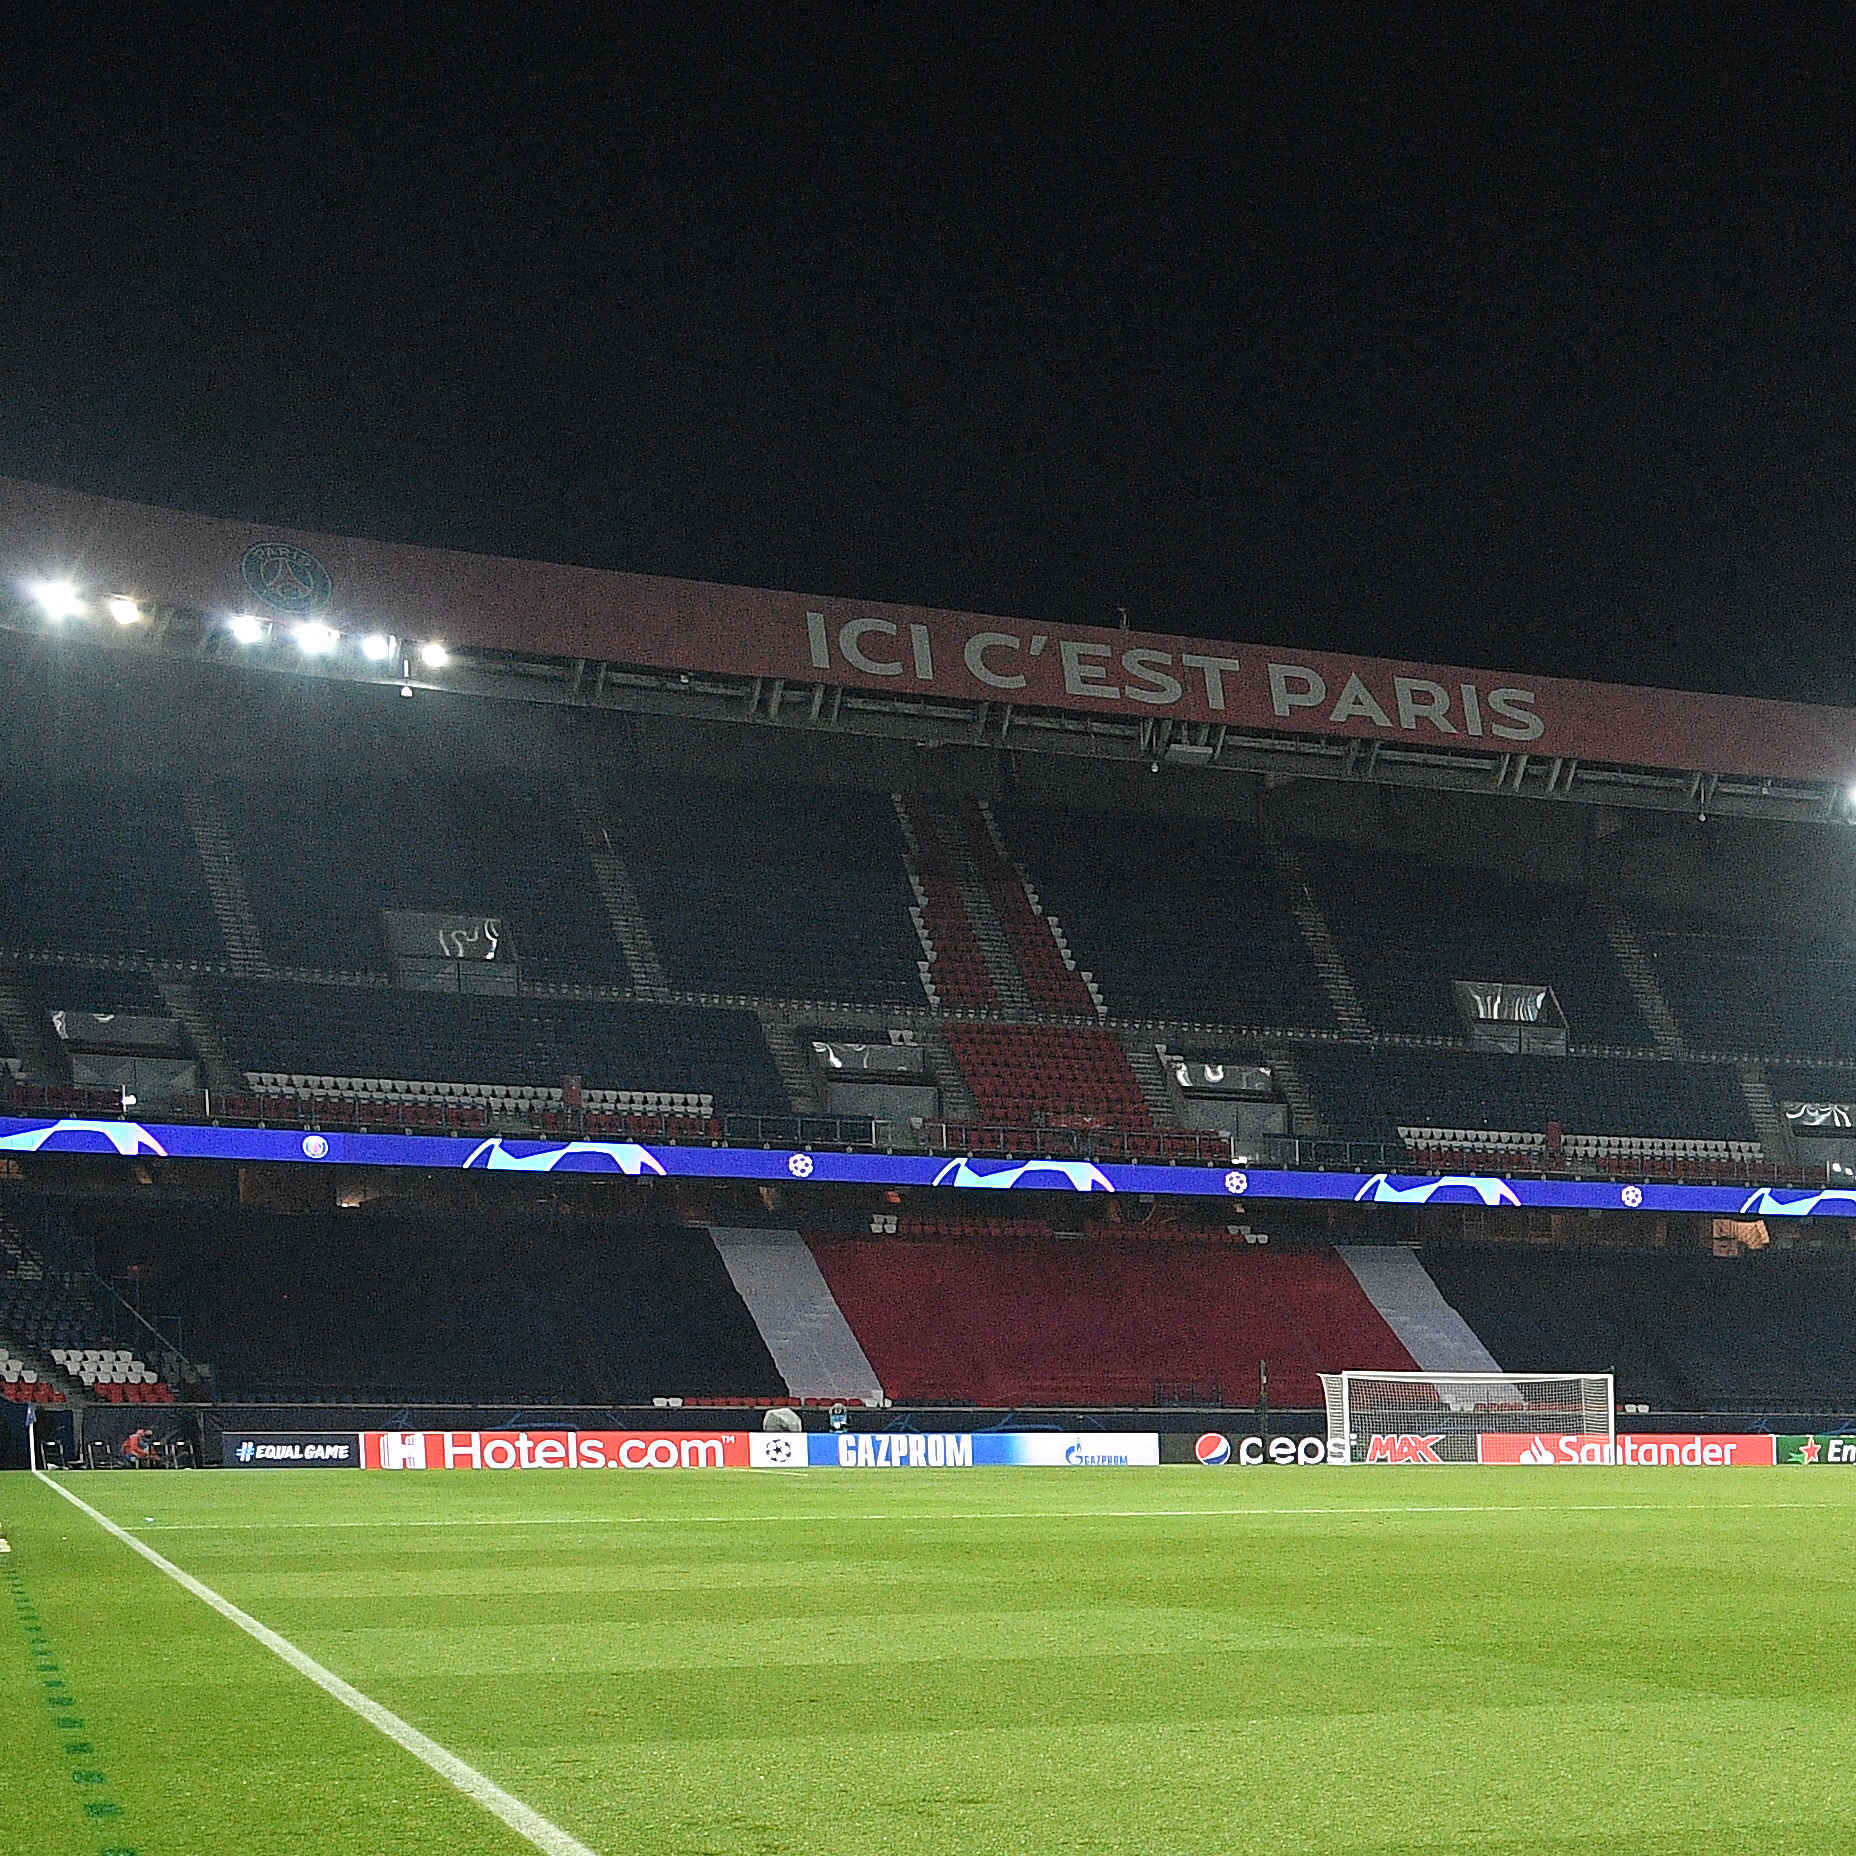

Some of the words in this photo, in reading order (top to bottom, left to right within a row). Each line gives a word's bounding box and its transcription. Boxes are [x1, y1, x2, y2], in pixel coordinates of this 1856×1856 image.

[804, 611, 935, 681] ICI
[963, 631, 1240, 711] C'EST
[1265, 662, 1546, 742] PARIS
[838, 1434, 973, 1466] GAZPROM
[1365, 1433, 1447, 1464] MAX
[1558, 1435, 1737, 1465] Santander
